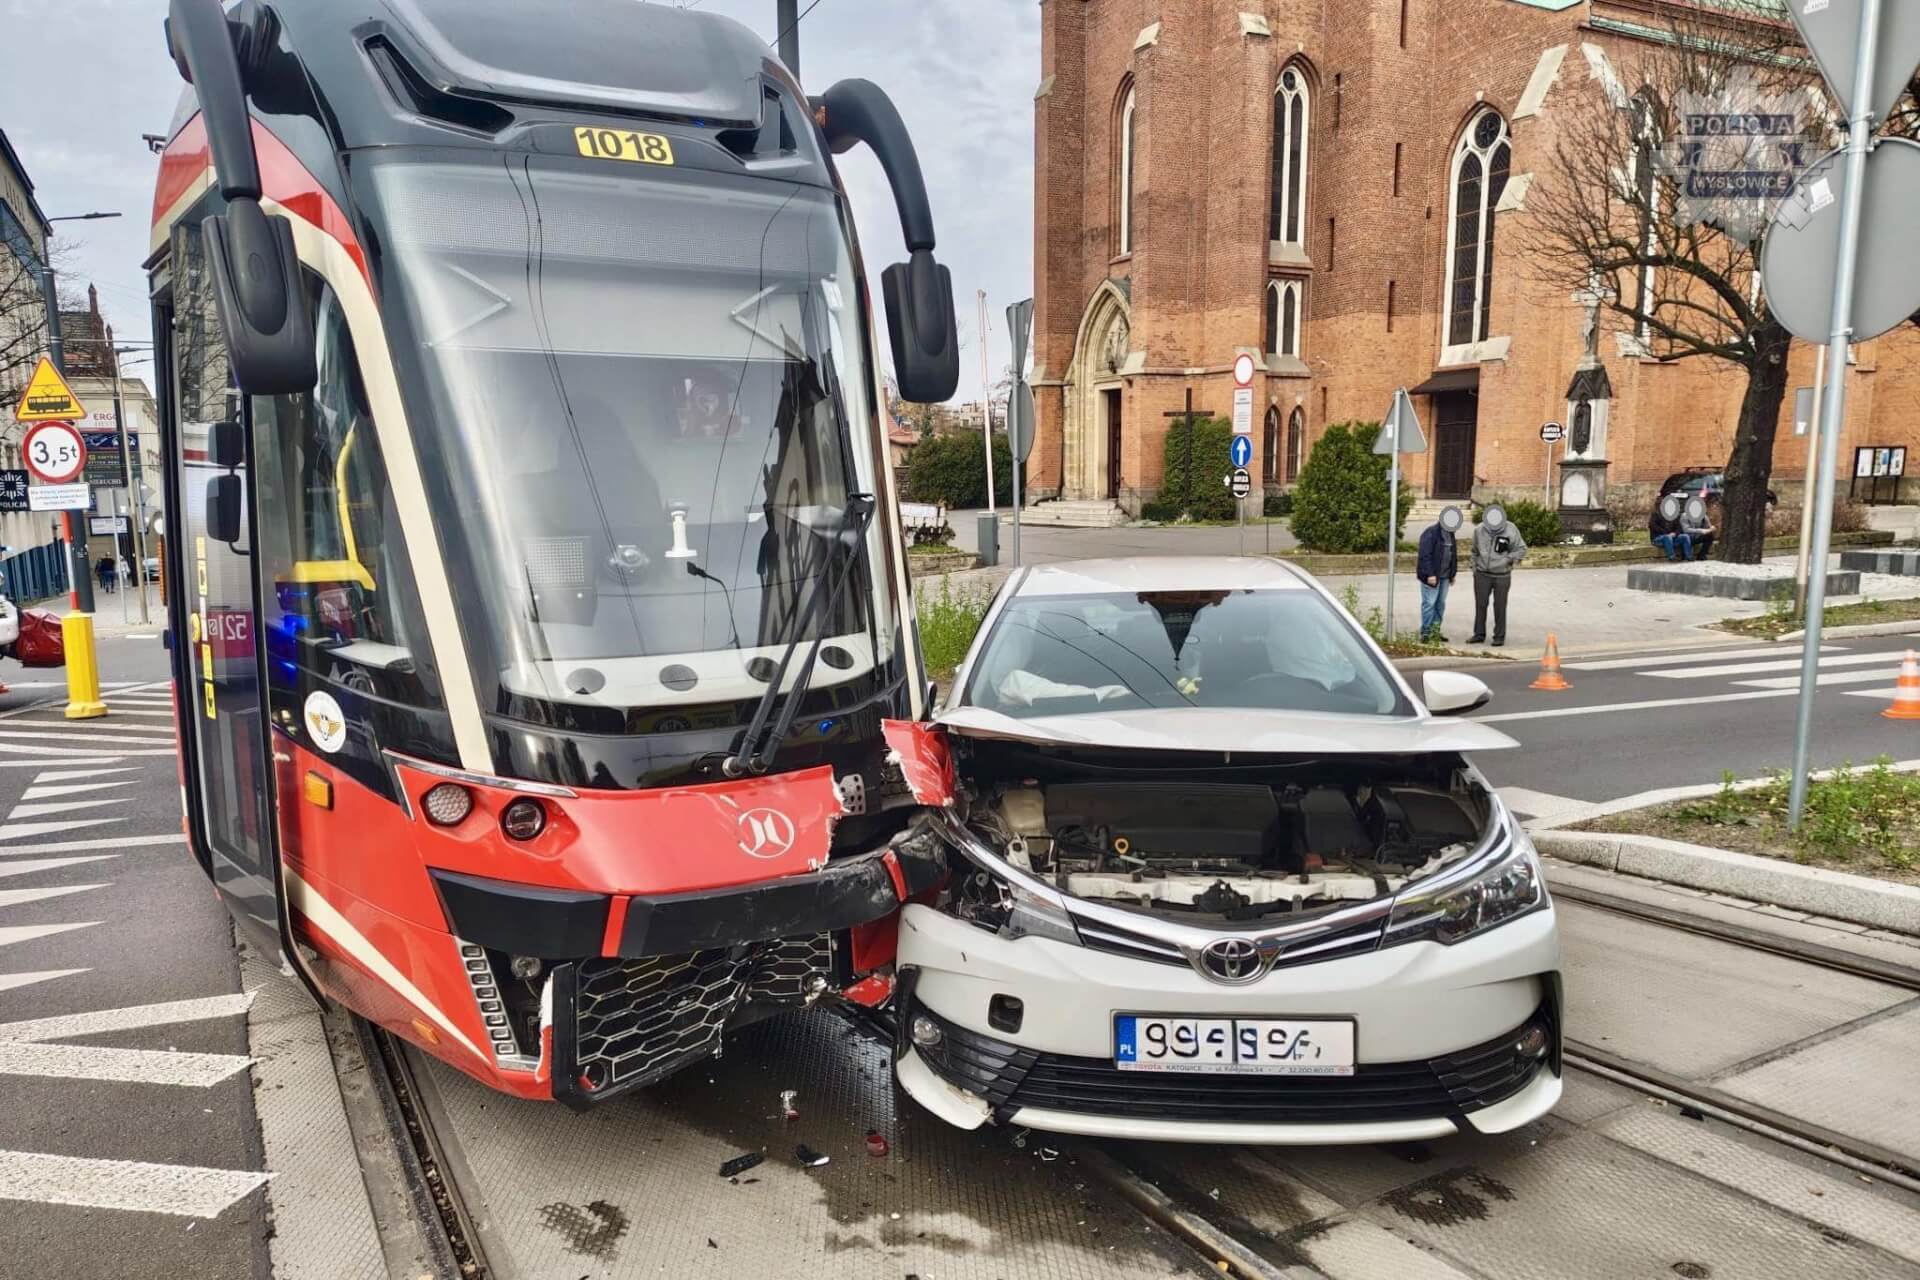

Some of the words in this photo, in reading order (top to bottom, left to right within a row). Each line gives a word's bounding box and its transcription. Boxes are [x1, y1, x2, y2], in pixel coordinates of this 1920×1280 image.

[578, 128, 668, 162] 1018
[34, 441, 77, 467] 3,5t
[1121, 1045, 1135, 1055] PL
